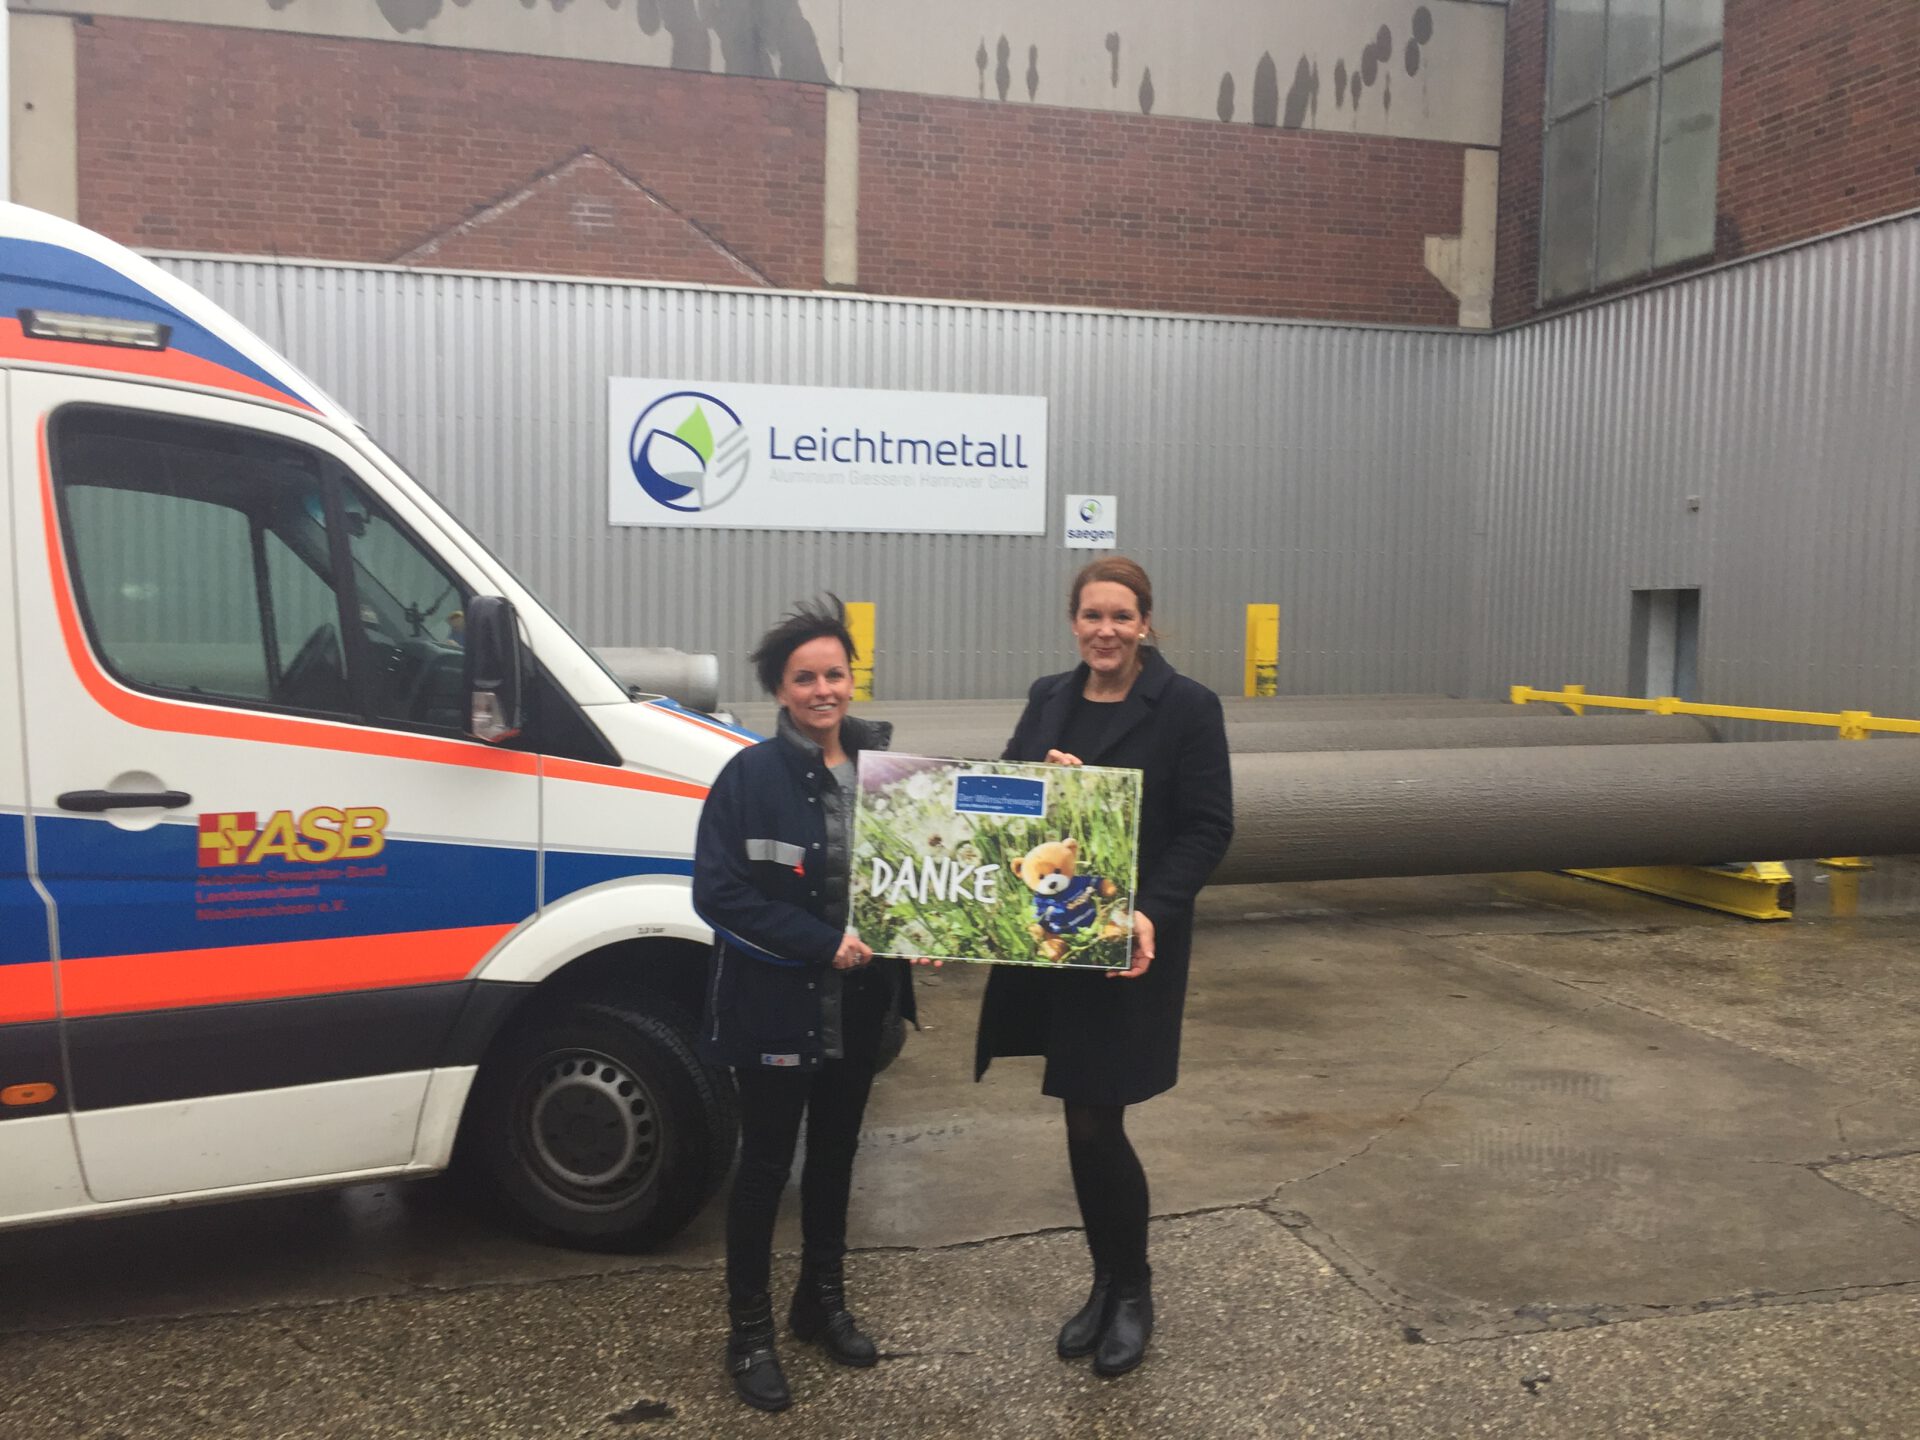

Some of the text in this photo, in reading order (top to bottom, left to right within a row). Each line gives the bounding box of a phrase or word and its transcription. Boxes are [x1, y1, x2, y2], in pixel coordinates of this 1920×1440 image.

[769, 426, 1028, 469] Leichtmetall
[769, 468, 1030, 491] Aluminium Giesserei Hannover GmbH
[1066, 529, 1114, 542] saegen
[244, 806, 388, 864] ASB
[870, 855, 1000, 905] DANKE
